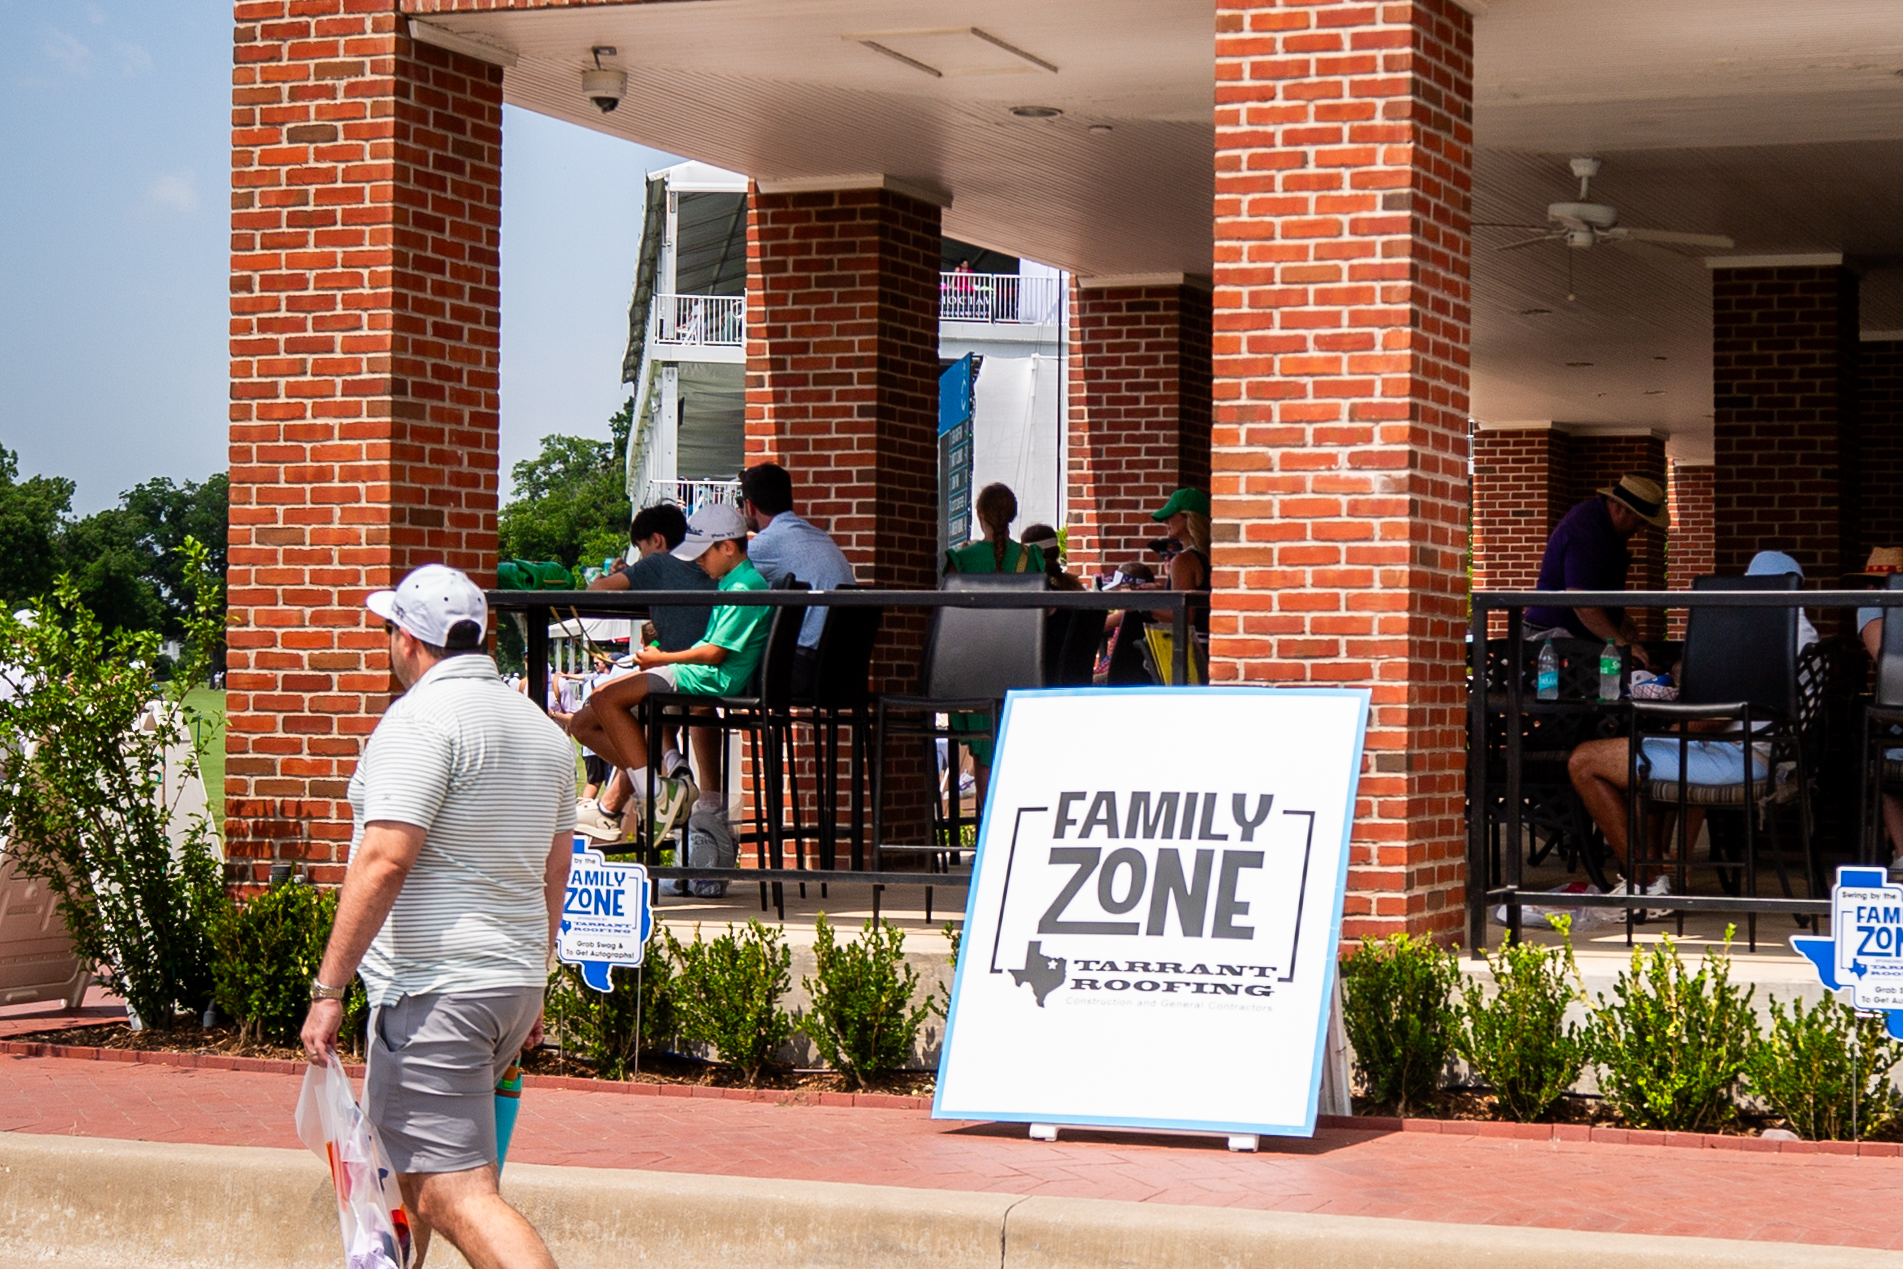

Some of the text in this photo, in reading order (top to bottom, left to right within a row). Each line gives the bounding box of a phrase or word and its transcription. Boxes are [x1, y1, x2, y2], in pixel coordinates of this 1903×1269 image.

[1053, 791, 1275, 842] FAMILY
[585, 857, 596, 865] the
[571, 870, 626, 887] AMILY
[1037, 846, 1266, 940] ZONE
[1842, 891, 1897, 901] Swing by the
[563, 887, 625, 917] ZONE
[577, 940, 595, 948] Grab
[597, 941, 616, 950] Swag
[590, 950, 635, 959] Autographs!
[1073, 959, 1278, 978] TARRANT
[1070, 978, 1275, 997] ROOFING
[1875, 986, 1897, 994] Grab
[1065, 996, 1274, 1013] Construction and General Contractors
[1861, 995, 1871, 1003] To
[1873, 996, 1889, 1004] Get
